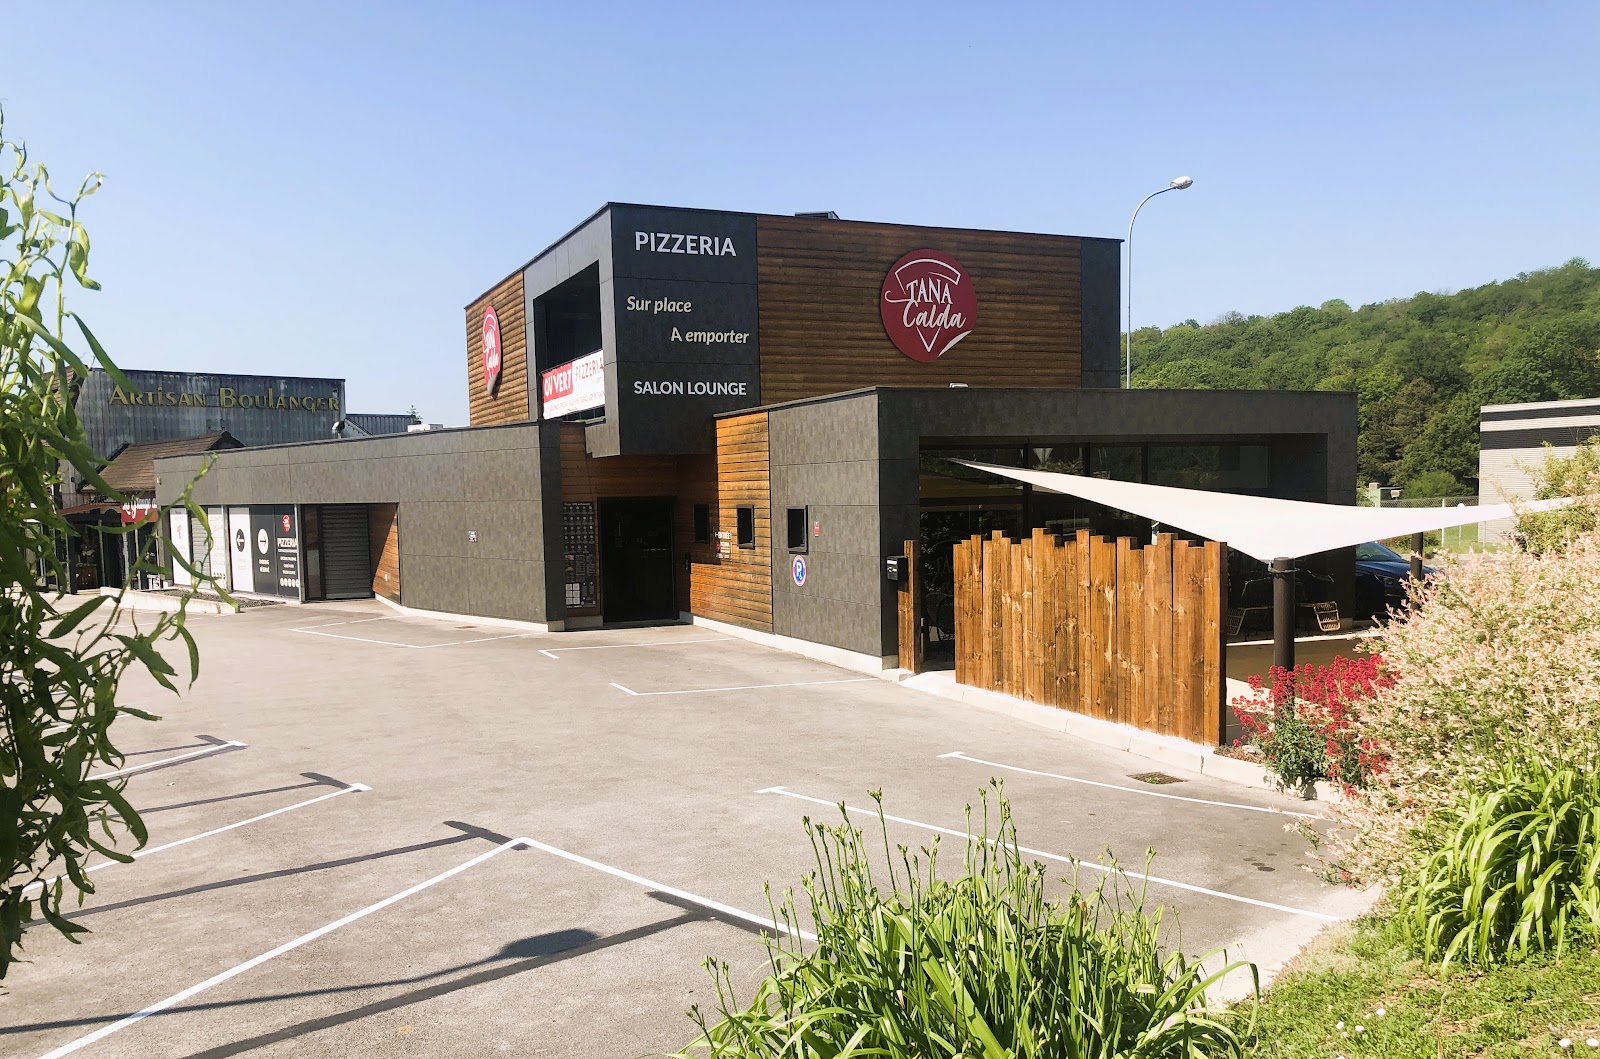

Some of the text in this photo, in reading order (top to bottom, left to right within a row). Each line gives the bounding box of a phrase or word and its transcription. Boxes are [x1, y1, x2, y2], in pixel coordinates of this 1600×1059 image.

[634, 231, 737, 257] PIZZERIA
[905, 277, 953, 304] TANA
[626, 296, 692, 314] Sur place
[902, 300, 967, 330] Calda
[671, 327, 749, 346] A emporter
[633, 380, 747, 396] SALON LOUNGE
